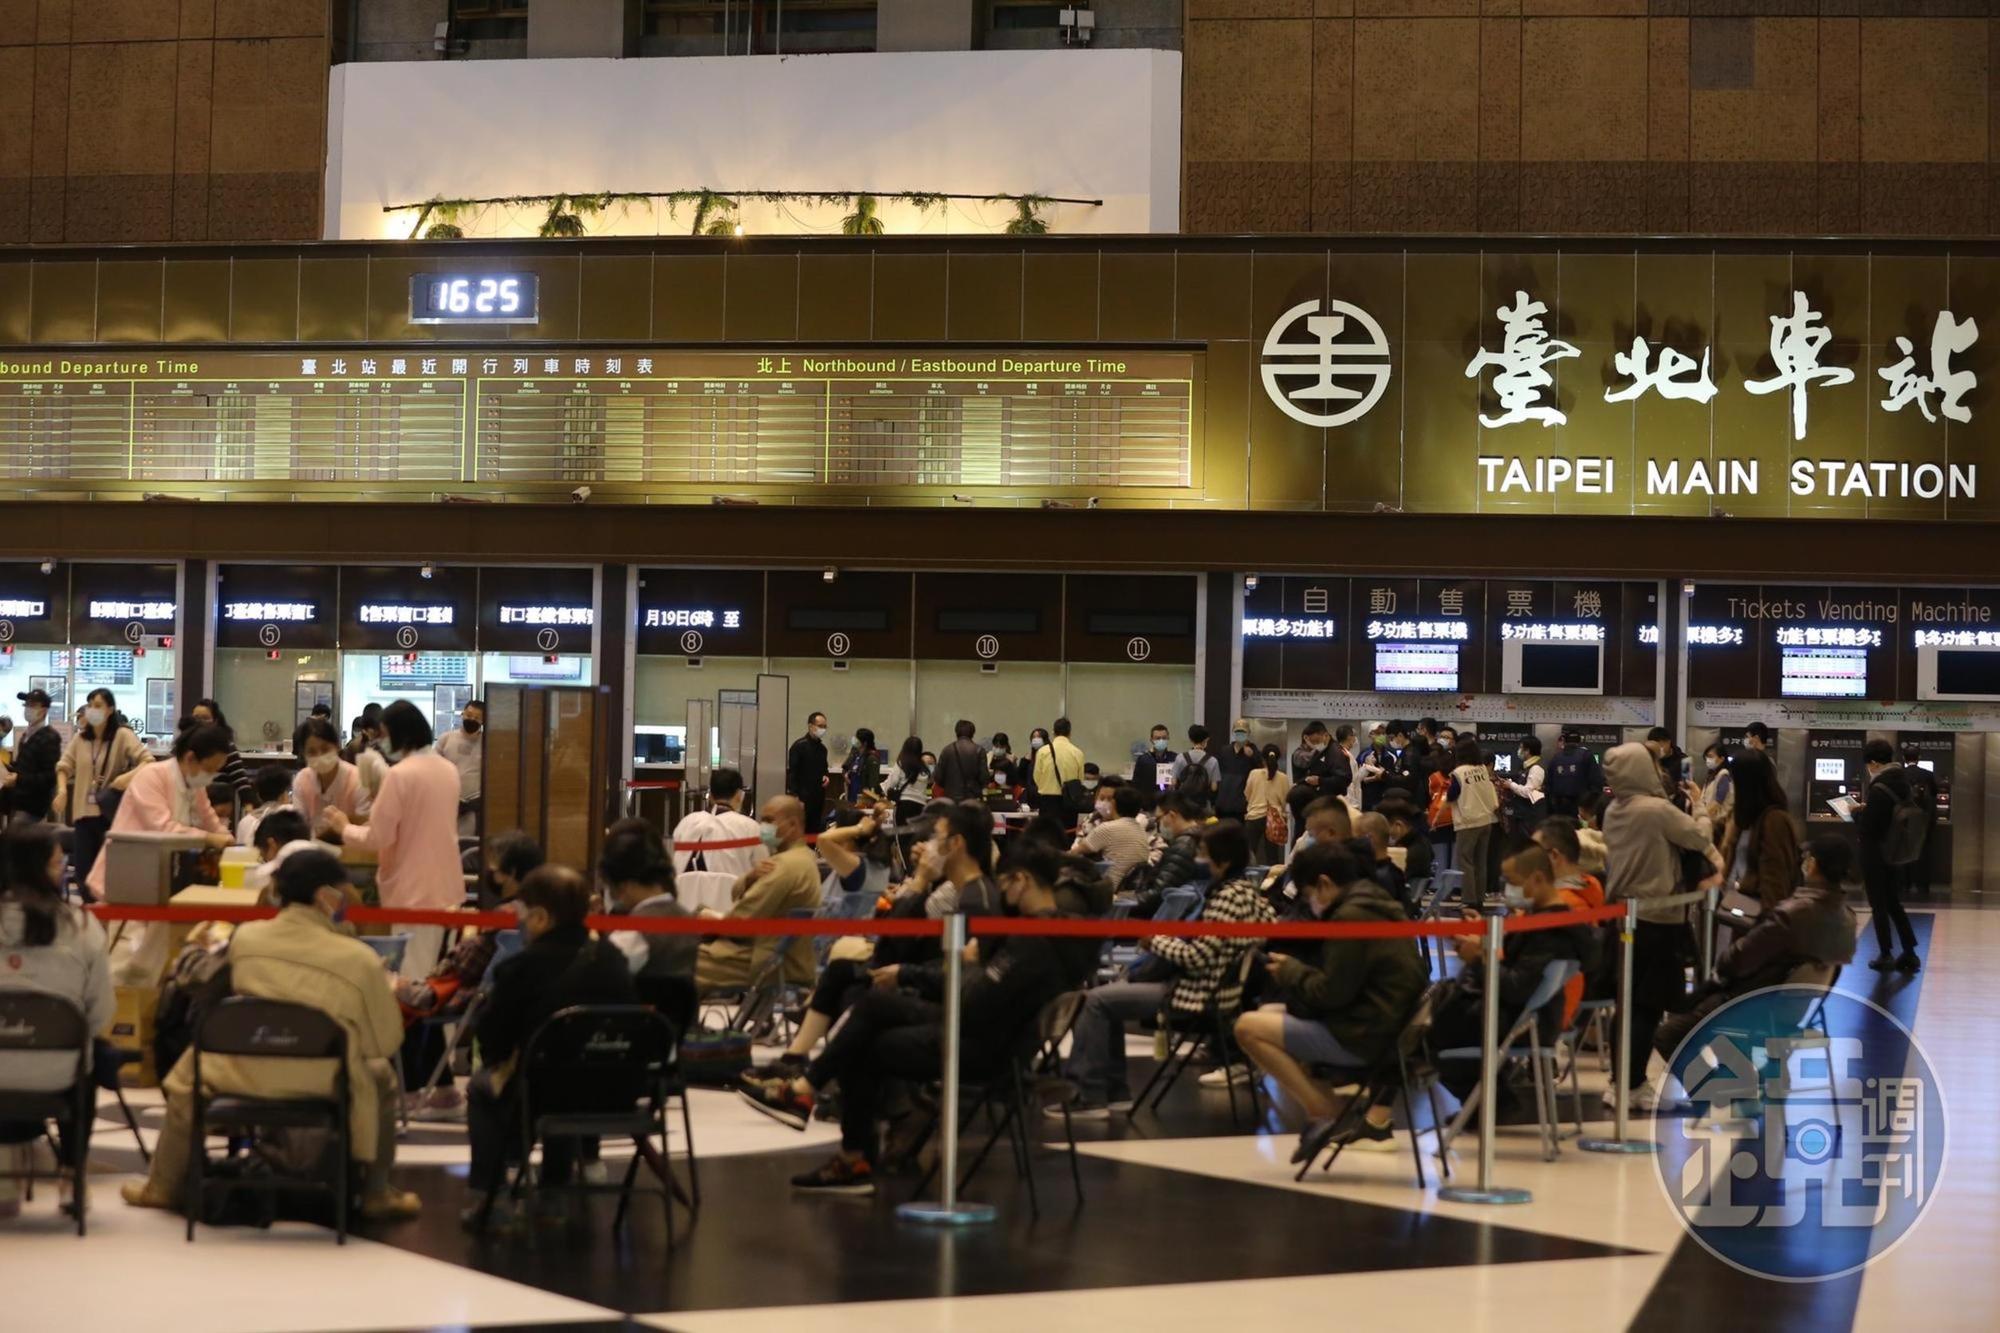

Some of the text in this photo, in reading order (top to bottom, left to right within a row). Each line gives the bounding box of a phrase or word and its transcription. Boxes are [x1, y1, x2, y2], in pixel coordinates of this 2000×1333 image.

[0, 360, 199, 376] bound Departure Time
[302, 358, 653, 376] 臺北站最近開行列車時刻表
[757, 357, 792, 374] 北上
[803, 359, 896, 373] Northbound
[911, 359, 996, 373] Eastbound
[1002, 359, 1082, 375] Departure
[1087, 359, 1126, 373] Time
[1465, 291, 1980, 440] 臺北車站
[1479, 458, 1977, 499] TAIPEI MAIN STATION
[1303, 585, 1601, 618] 自動售票機
[1728, 598, 1991, 622] Tickets Vending Machine
[723, 610, 740, 628] 至
